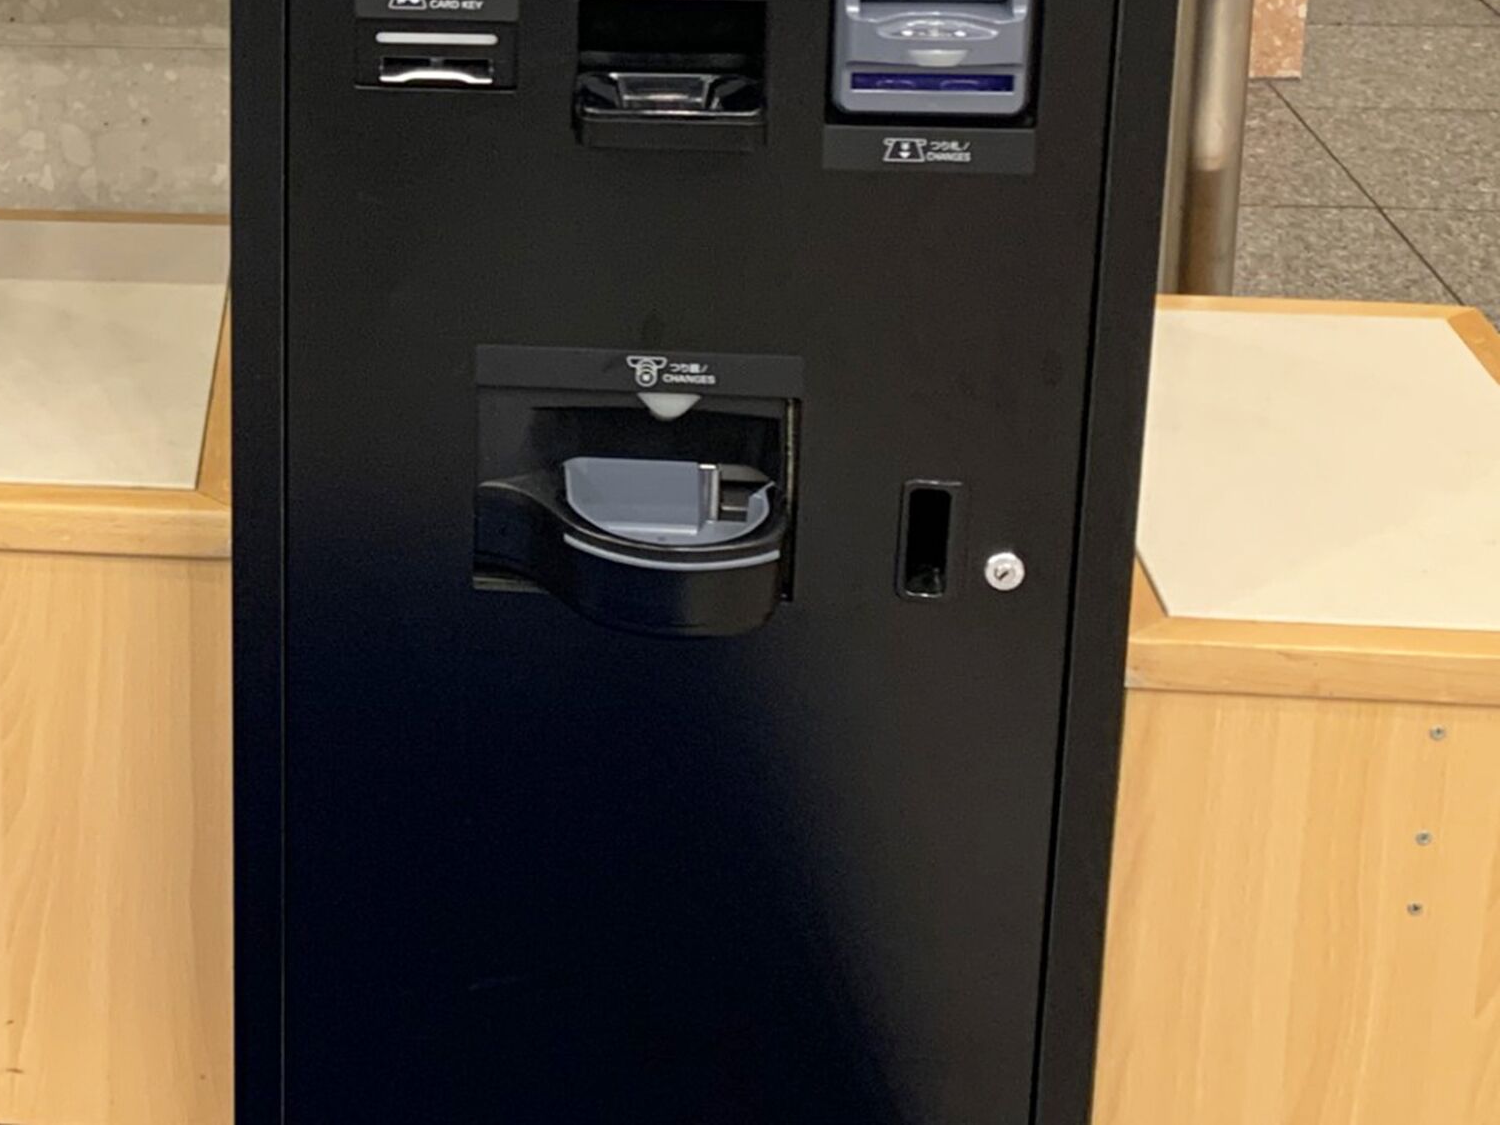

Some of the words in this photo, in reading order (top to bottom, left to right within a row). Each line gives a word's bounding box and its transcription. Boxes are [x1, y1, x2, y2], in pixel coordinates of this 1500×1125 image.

[429, 0, 460, 9] CARD
[461, 0, 484, 9] KEY
[926, 151, 972, 162] CHANGES
[662, 374, 716, 385] CHANGES
